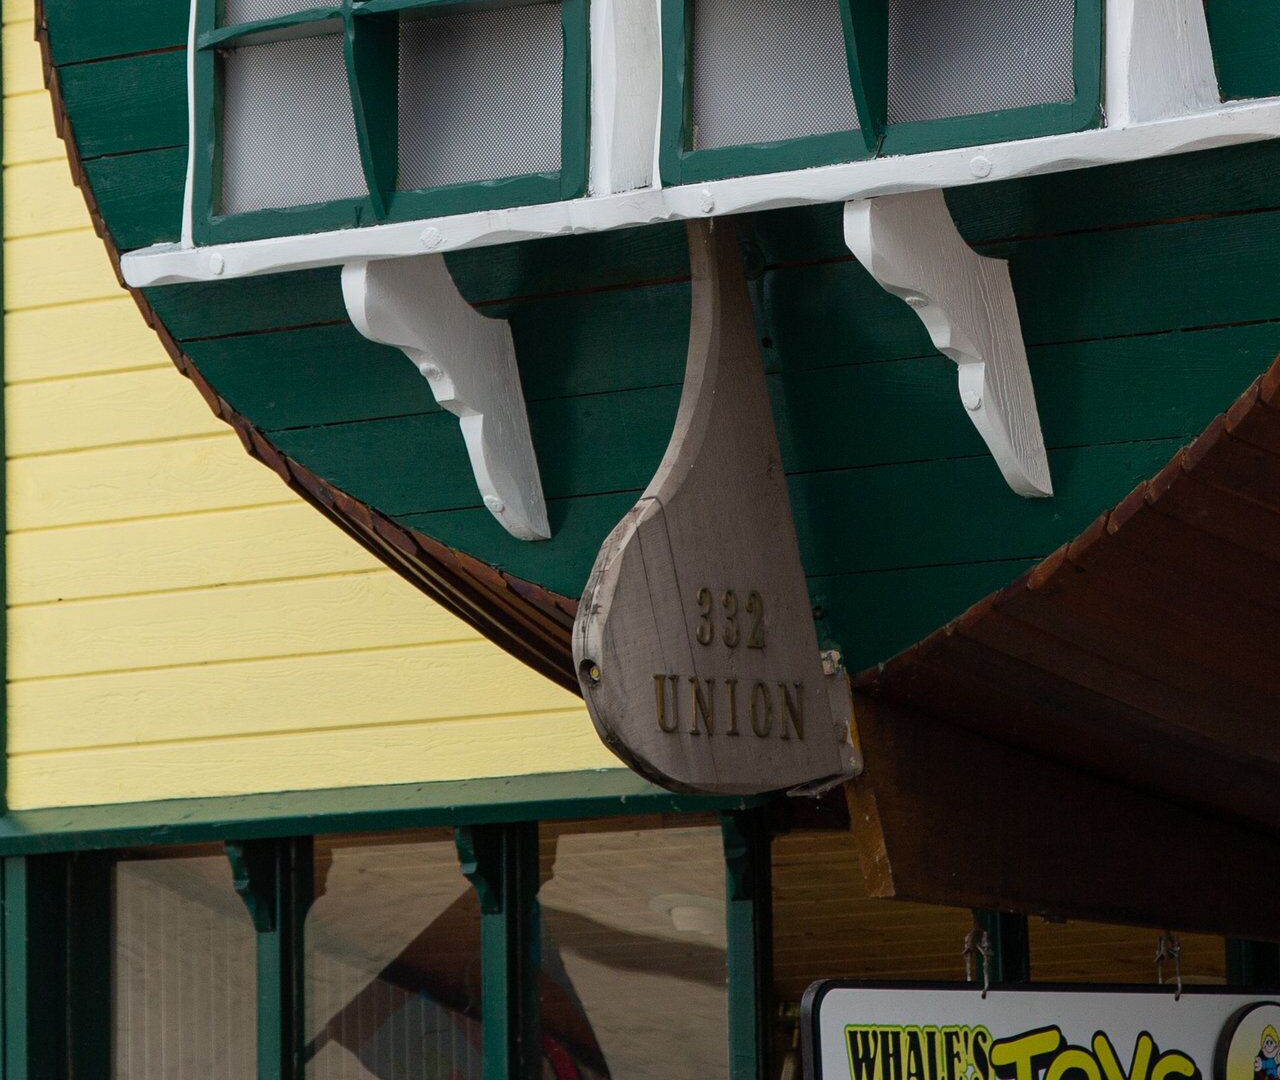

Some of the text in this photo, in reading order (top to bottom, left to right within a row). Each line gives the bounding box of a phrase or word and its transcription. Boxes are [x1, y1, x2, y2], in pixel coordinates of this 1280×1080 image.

[696, 587, 766, 649] 332
[653, 673, 804, 741] UNION
[845, 1024, 998, 1080] WHALE'S
